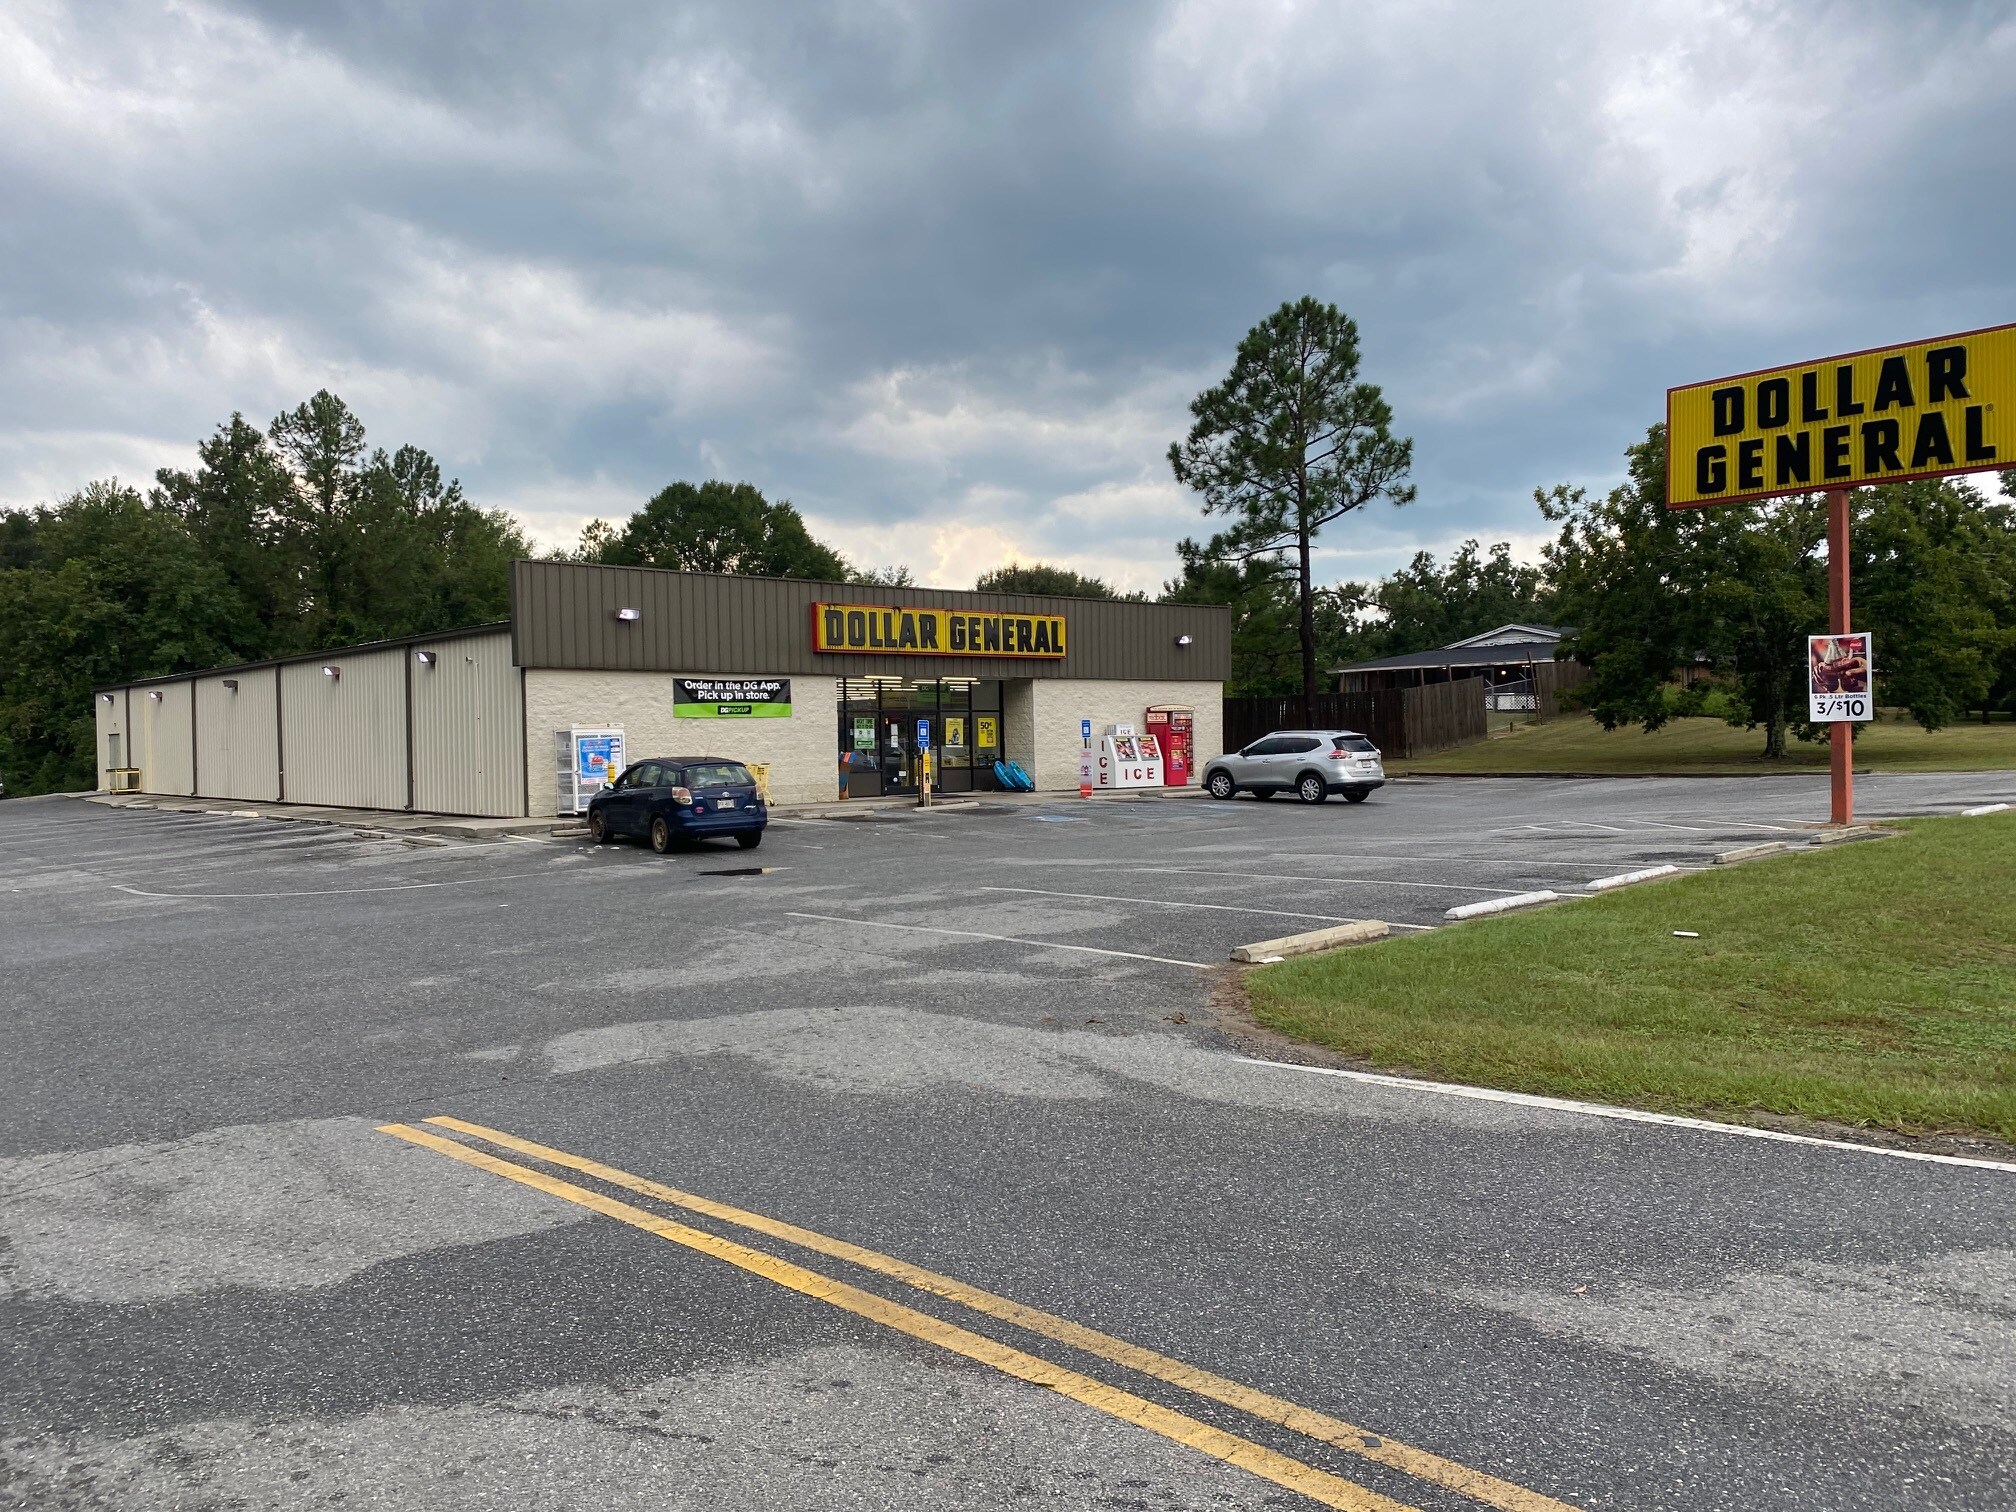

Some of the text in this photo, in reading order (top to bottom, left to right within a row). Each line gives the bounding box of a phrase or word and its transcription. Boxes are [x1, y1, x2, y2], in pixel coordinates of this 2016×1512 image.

[1712, 345, 1971, 437] DOLLAR
[1696, 405, 1996, 495] GENERAL
[825, 610, 1063, 654] DOLLAR GENERAL
[684, 680, 781, 692] Order in the DG App.
[698, 691, 718, 700] Pick
[720, 693, 733, 701] up
[735, 691, 743, 699] in
[1817, 700, 1865, 716] 3/$10
[1099, 740, 1108, 784] ICE
[1125, 767, 1155, 780] ICE
